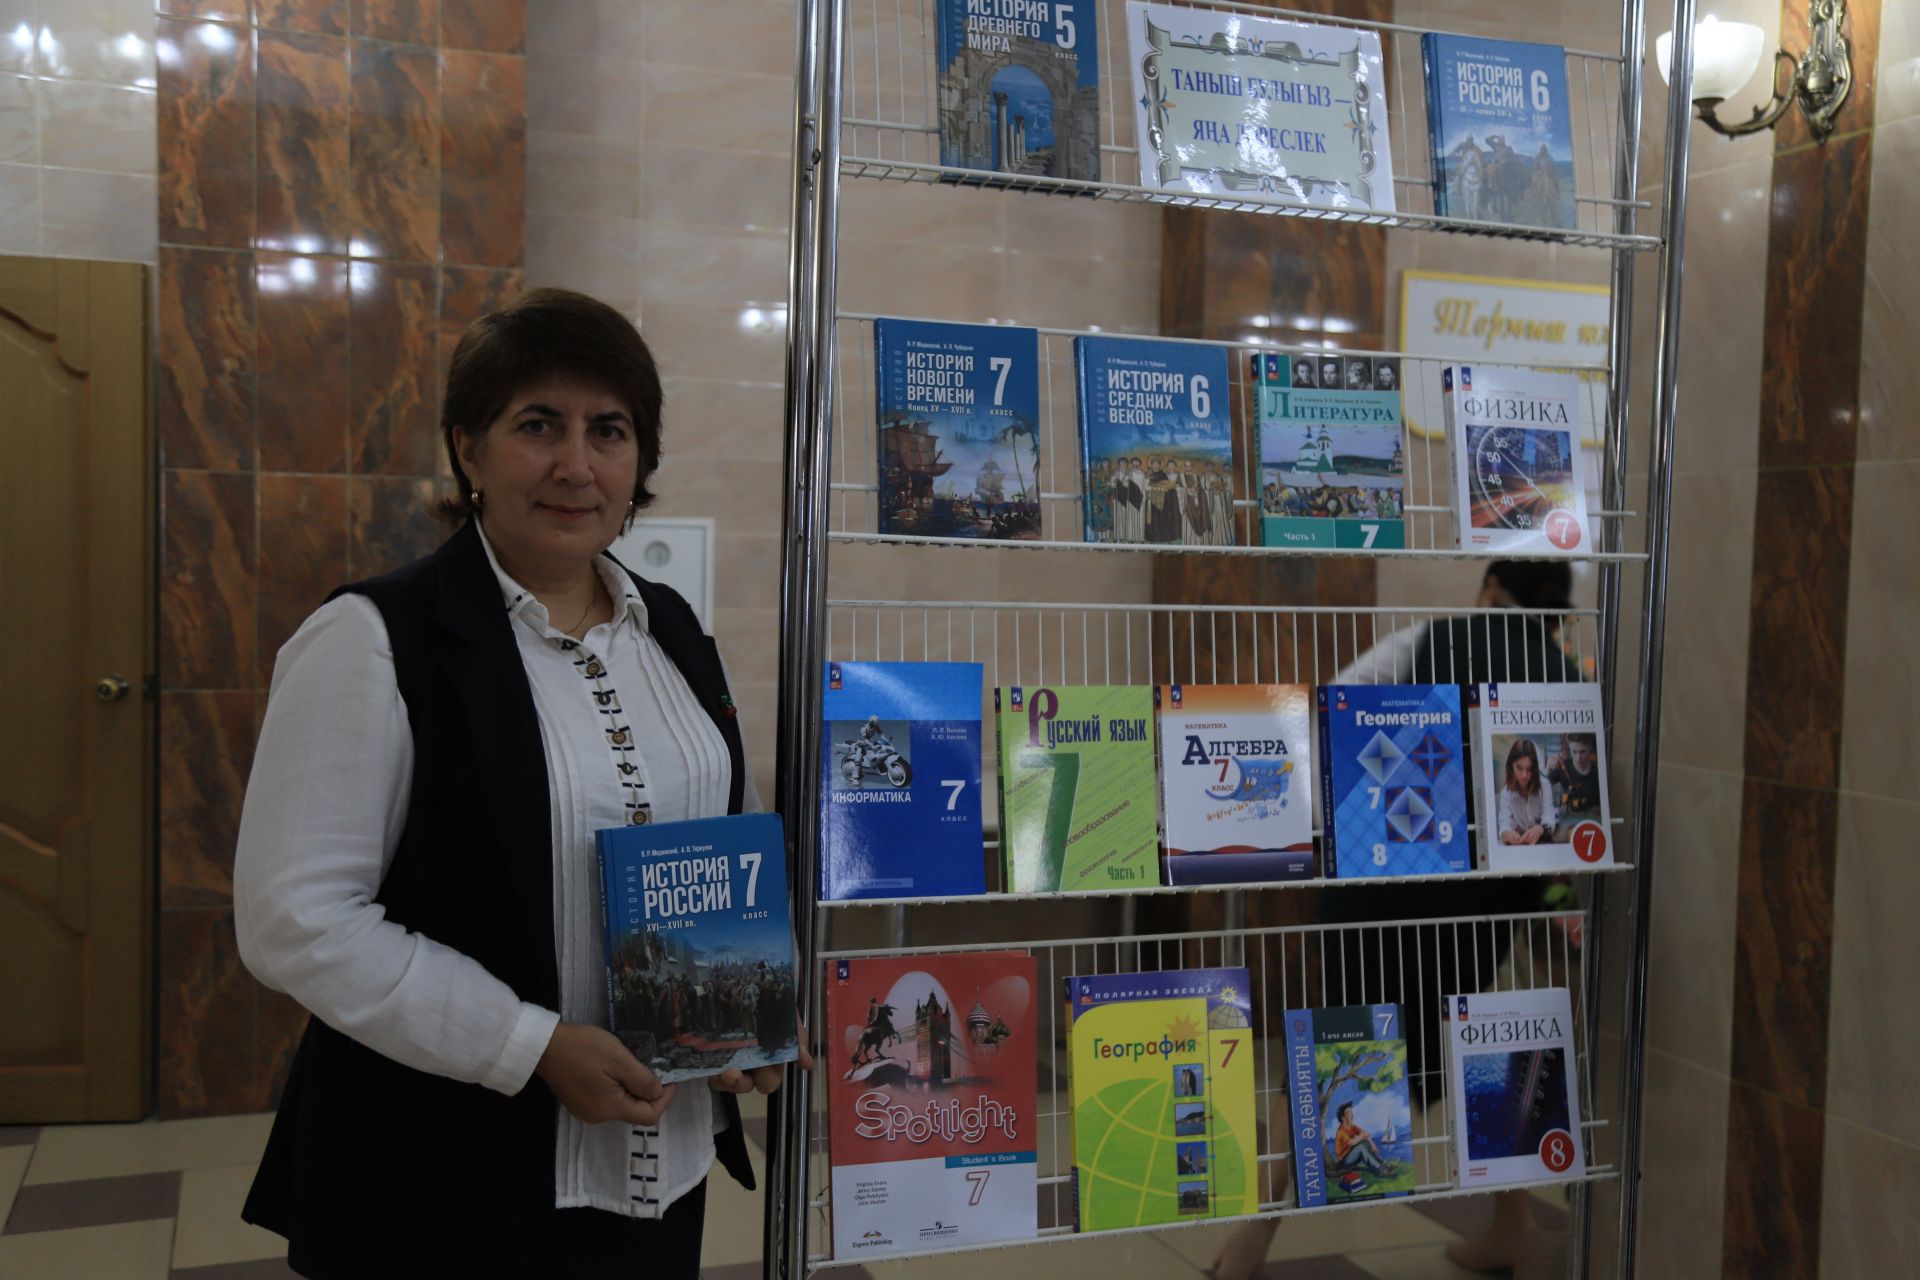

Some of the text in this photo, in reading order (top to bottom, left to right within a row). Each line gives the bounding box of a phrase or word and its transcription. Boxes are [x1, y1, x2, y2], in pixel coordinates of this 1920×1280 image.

[967, 0, 1049, 22] ИСТОРИЯ
[967, 15, 1041, 38] ДРЕВНЕГО
[1055, 4, 1076, 49] 5
[968, 33, 1011, 53] МИРА
[1171, 68, 1243, 97] ТАНЫШ
[1456, 62, 1523, 87] ИСТОРИЯ
[1459, 81, 1524, 109] РОССИИ
[1530, 69, 1550, 112] 6
[1193, 119, 1326, 154] ЯҢА ДРЕСЛЕК
[907, 352, 974, 372] ИСТОРИЯ
[907, 369, 964, 388] НОВОГО
[990, 357, 1012, 406] 7
[1108, 369, 1184, 394] ИСТОРИЯ
[907, 385, 975, 405] ВРЕМЕНИ
[1109, 391, 1174, 410] СРЕДНИХ
[1191, 375, 1210, 419] 6
[908, 403, 929, 413] Конец
[990, 408, 1013, 417] класс
[1110, 408, 1153, 425] ВЕКОВ
[1464, 397, 1569, 424] ФИЗИКА
[1487, 452, 1501, 463] 50
[1488, 474, 1502, 485] 45
[1517, 514, 1531, 526] 35
[1556, 518, 1569, 545] 7
[1284, 531, 1316, 541] Часть 1
[1360, 525, 1380, 548] 7
[1356, 711, 1451, 728] Геометрия
[1490, 710, 1595, 726] ТЕХНОЛОГИЯ
[1214, 759, 1230, 783] 7
[832, 790, 911, 804] ИНФОРМАТИКА
[940, 780, 966, 811] 7
[1368, 787, 1381, 809] 7
[1020, 752, 1080, 893] 7
[1439, 821, 1452, 843] 9
[1373, 844, 1387, 866] 8
[1583, 830, 1596, 857] 7
[642, 856, 730, 890] ИСТОРИЯ
[739, 852, 762, 907] 7
[1108, 865, 1146, 881] Часть 1
[627, 865, 640, 935] ИСТОРИЯ
[644, 882, 732, 919] РОССИИ
[743, 911, 768, 920] класс
[1095, 986, 1213, 1000] ПОЛЯРНАЯ ЗВЕЗДА
[1376, 1013, 1394, 1036] 7
[1460, 1018, 1563, 1044] ФИЗИКА
[1094, 1034, 1196, 1062] География
[1220, 1039, 1240, 1068] 7
[1296, 1044, 1315, 1139] ӘДӘБИЯТЫ
[855, 1092, 1017, 1144] Spotlight
[1551, 1138, 1566, 1167] 8
[1303, 1149, 1320, 1200] ТАТАР
[966, 1171, 990, 1206] 7
